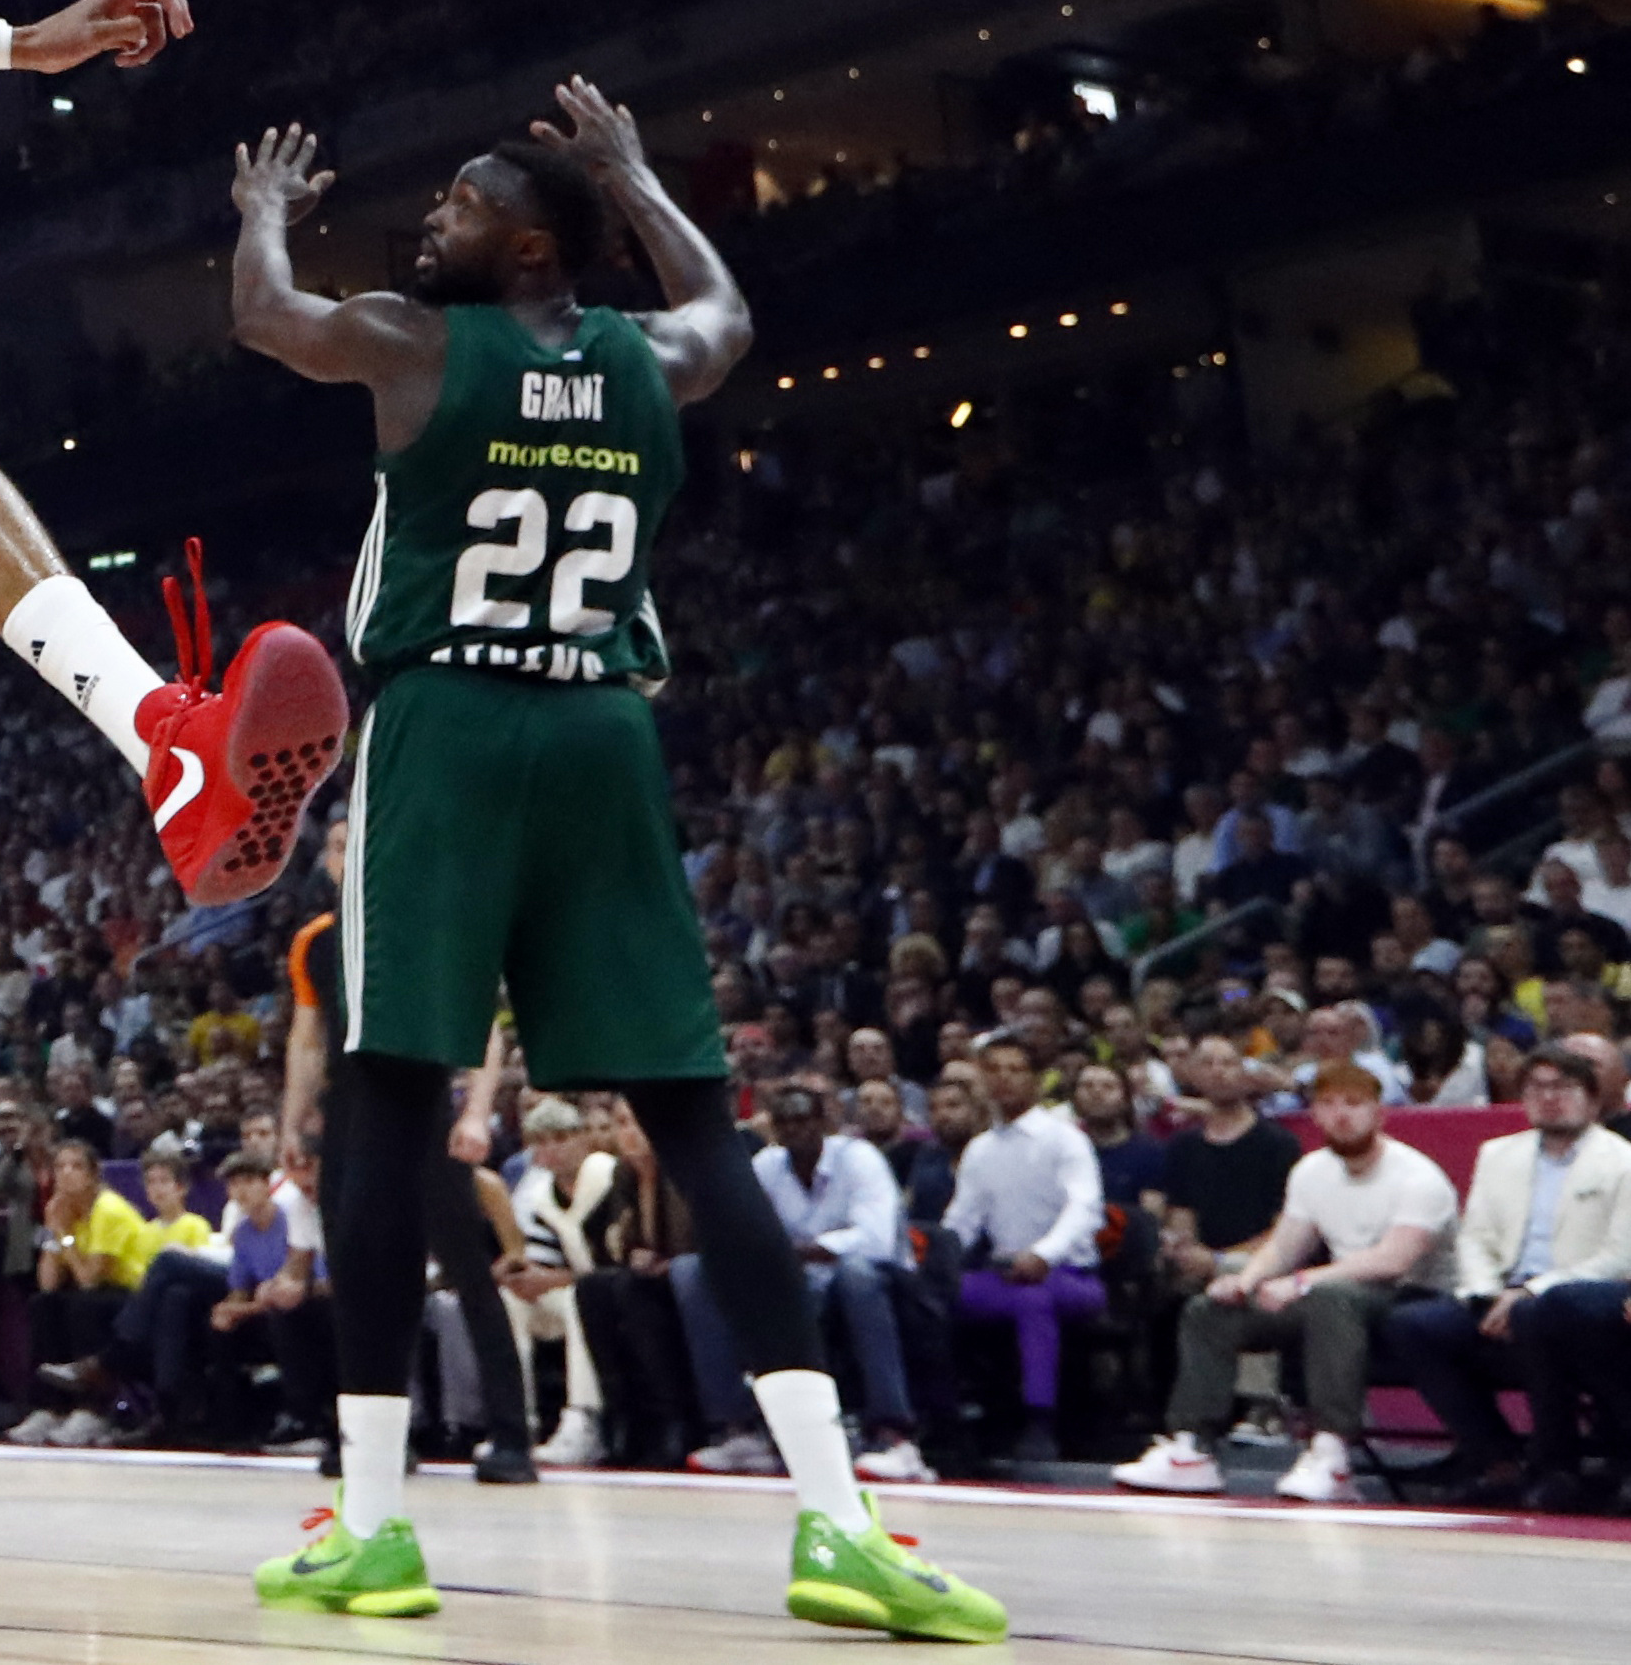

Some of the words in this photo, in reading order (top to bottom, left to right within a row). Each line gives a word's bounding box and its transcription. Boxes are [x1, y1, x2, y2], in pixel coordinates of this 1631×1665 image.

[521, 371, 605, 422] GRANT
[488, 440, 640, 476] more.com
[450, 488, 638, 634] 22
